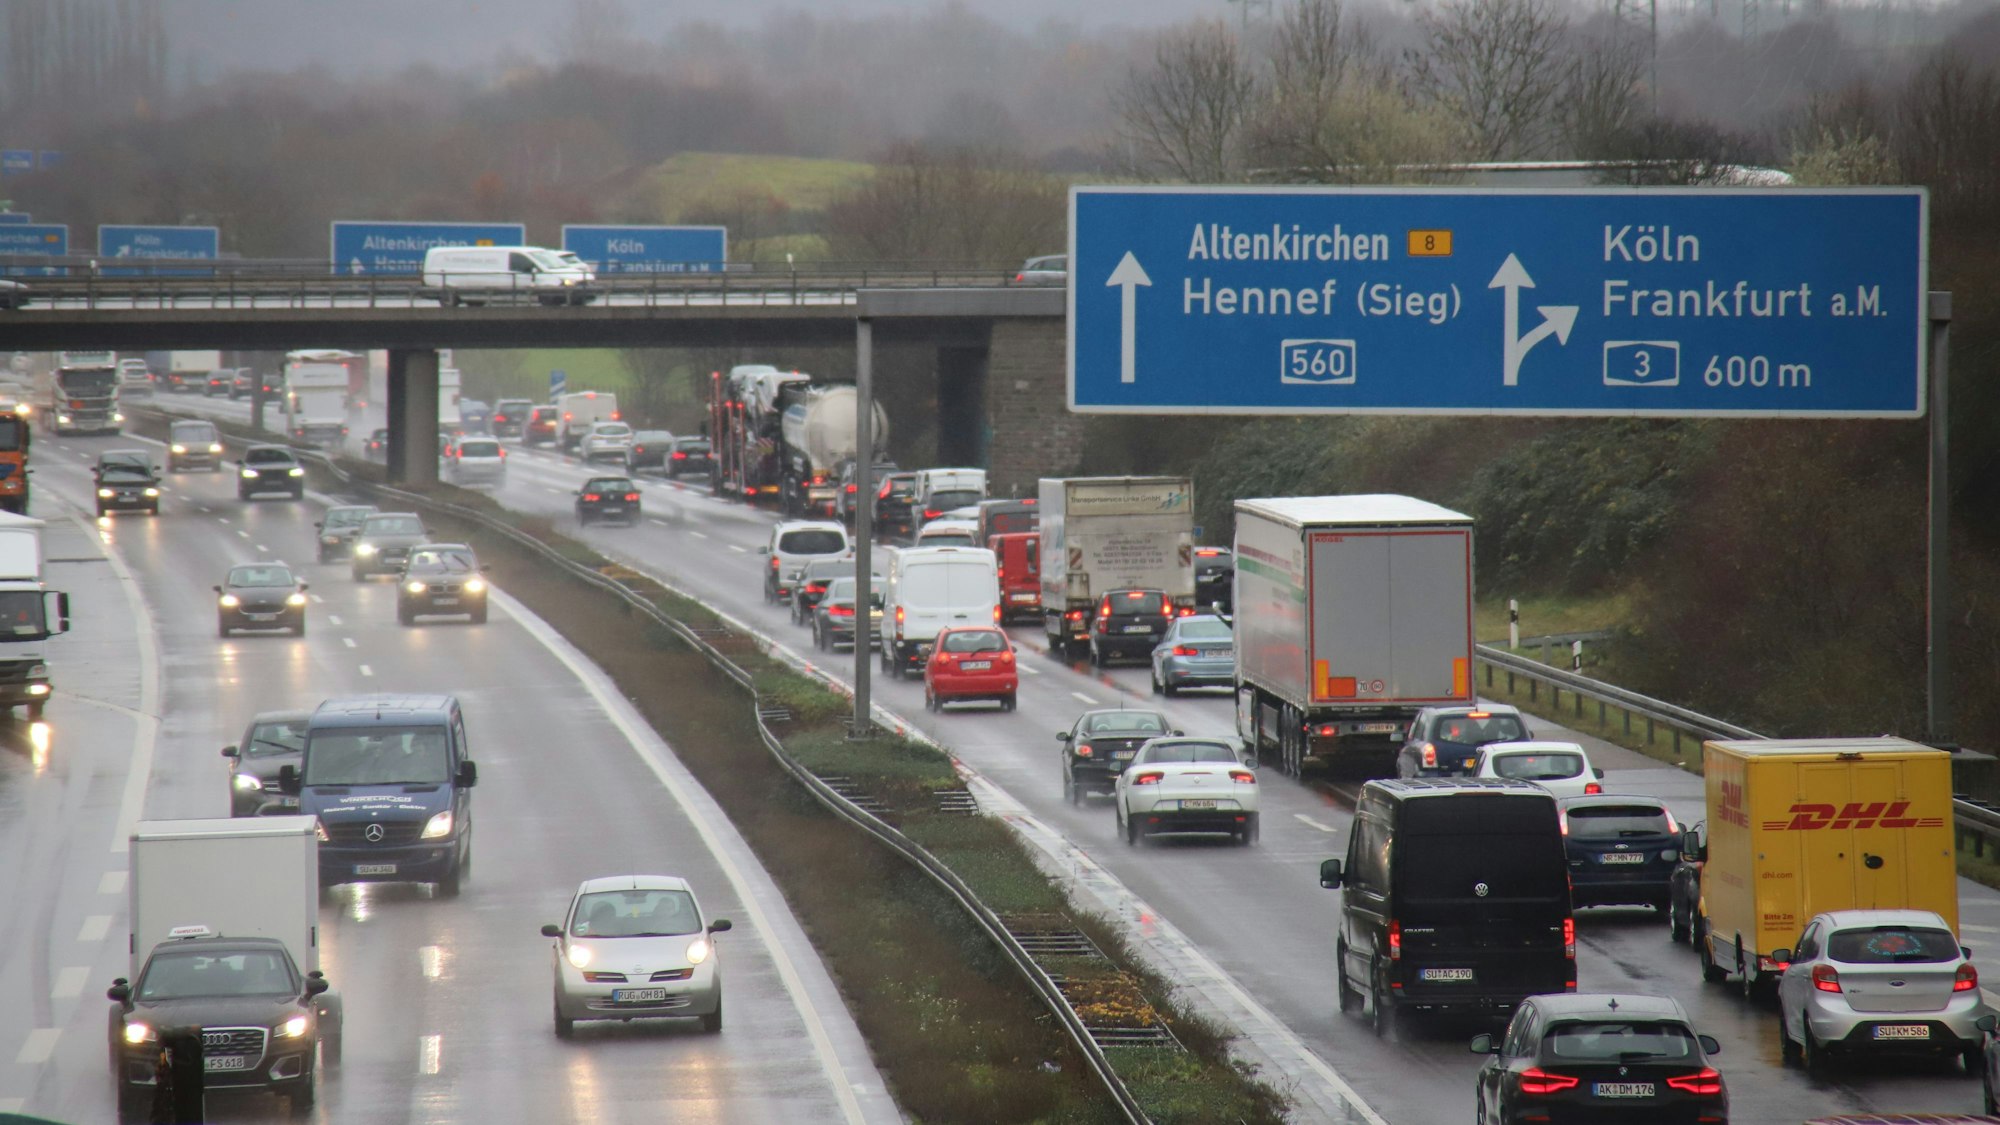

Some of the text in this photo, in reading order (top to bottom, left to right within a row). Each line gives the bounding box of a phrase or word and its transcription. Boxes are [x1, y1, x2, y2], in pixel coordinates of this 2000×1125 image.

[363, 235, 468, 250] Altenkirchen
[607, 239, 645, 253] Köln
[1188, 223, 1435, 261] Altenkirchen 8
[1604, 224, 1699, 262] Köln
[1183, 278, 1461, 325] Hennef (Sieg)
[1603, 279, 1888, 317] Frankfurt a.M.
[1292, 349, 1345, 376] 560
[1634, 351, 1811, 387] 3 600 m
[1787, 801, 1920, 830] DHL
[1628, 853, 1643, 861] 777
[1762, 871, 1793, 880] dhl.com
[1764, 913, 1781, 921] Bitte
[1425, 969, 1471, 979] SU AC 190
[618, 990, 664, 1000] RÜG OH 81
[1879, 1027, 1928, 1036] SU KM 586
[210, 1057, 243, 1069] FS 618
[1599, 1084, 1654, 1095] AK DM 176
